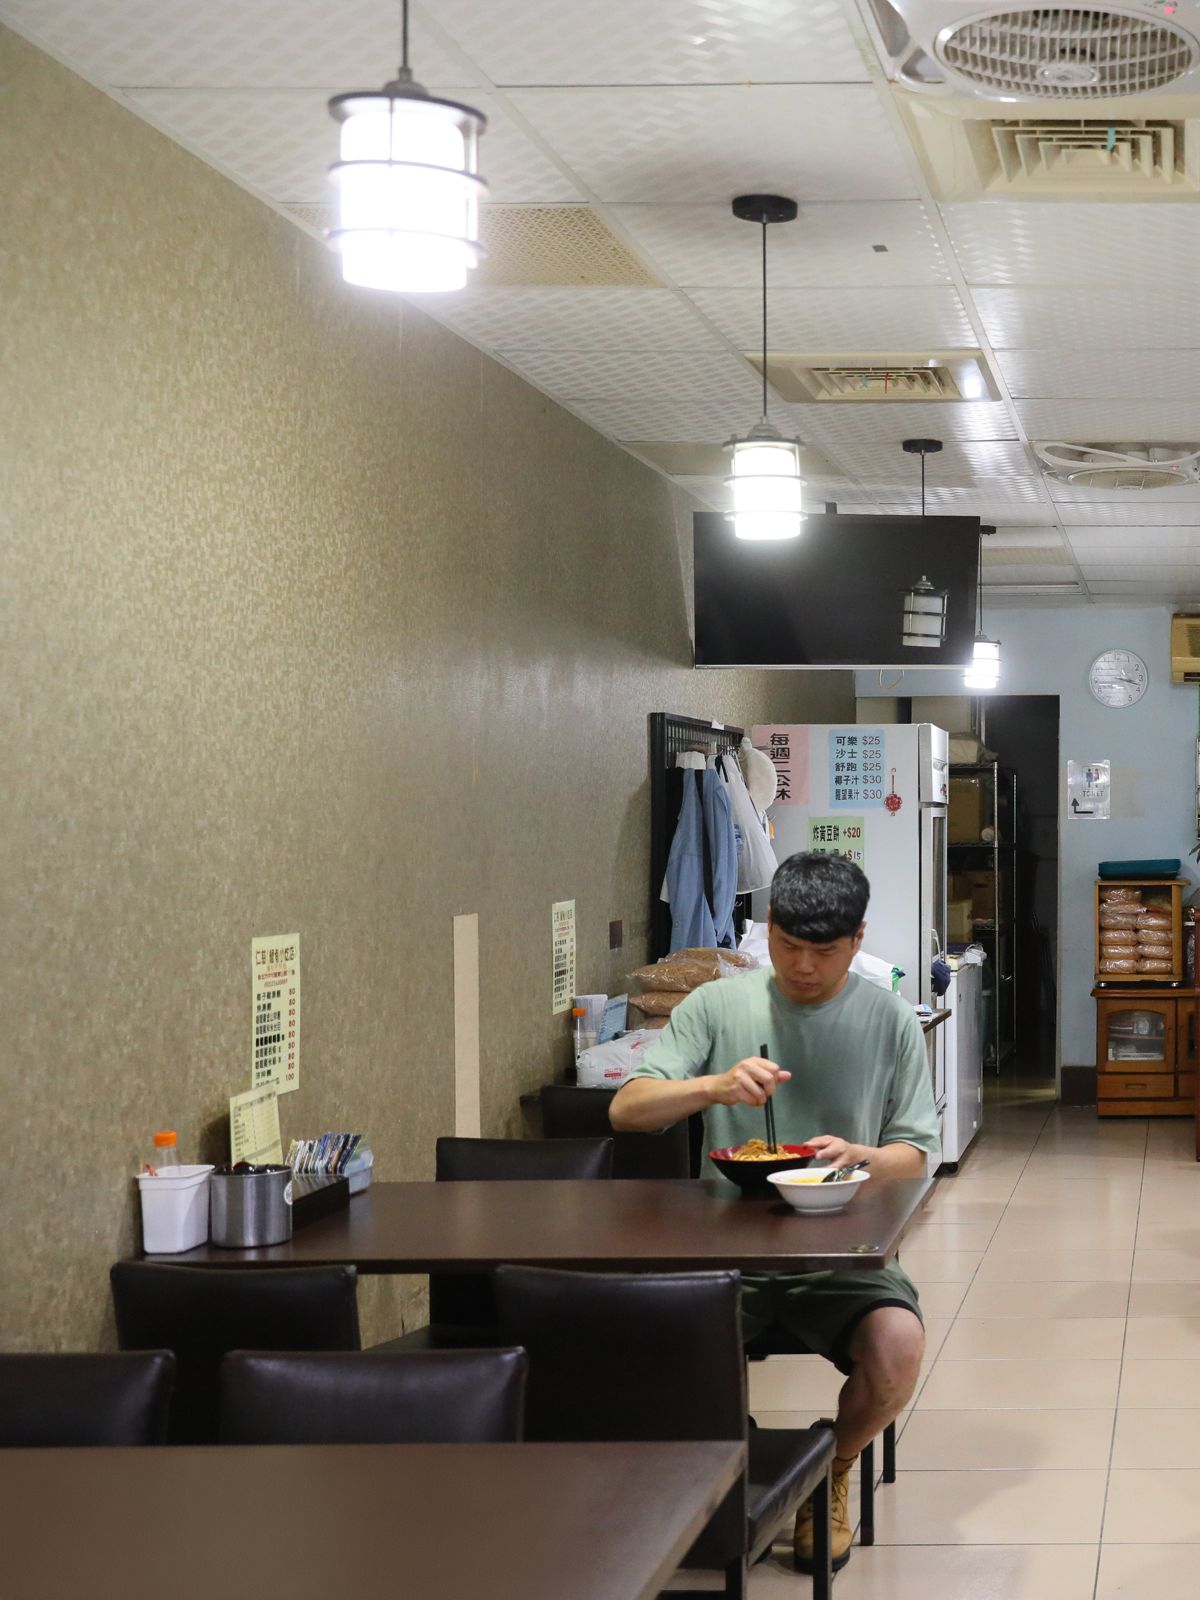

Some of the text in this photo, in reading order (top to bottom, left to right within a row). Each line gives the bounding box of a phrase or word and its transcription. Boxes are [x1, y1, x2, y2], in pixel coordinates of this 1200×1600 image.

[836, 735, 880, 746] 可樂 $25
[835, 748, 881, 759] 沙士 $25
[835, 762, 881, 772] 舒跑 $25
[834, 775, 882, 785] 椰子汁 $30
[862, 789, 882, 800] $30
[843, 826, 861, 839] +$20
[288, 987, 296, 996] 80
[288, 998, 296, 1006] 80
[288, 1020, 296, 1028] 80
[288, 1030, 295, 1039] 80
[288, 1042, 295, 1050] 80
[287, 1053, 295, 1061] 80
